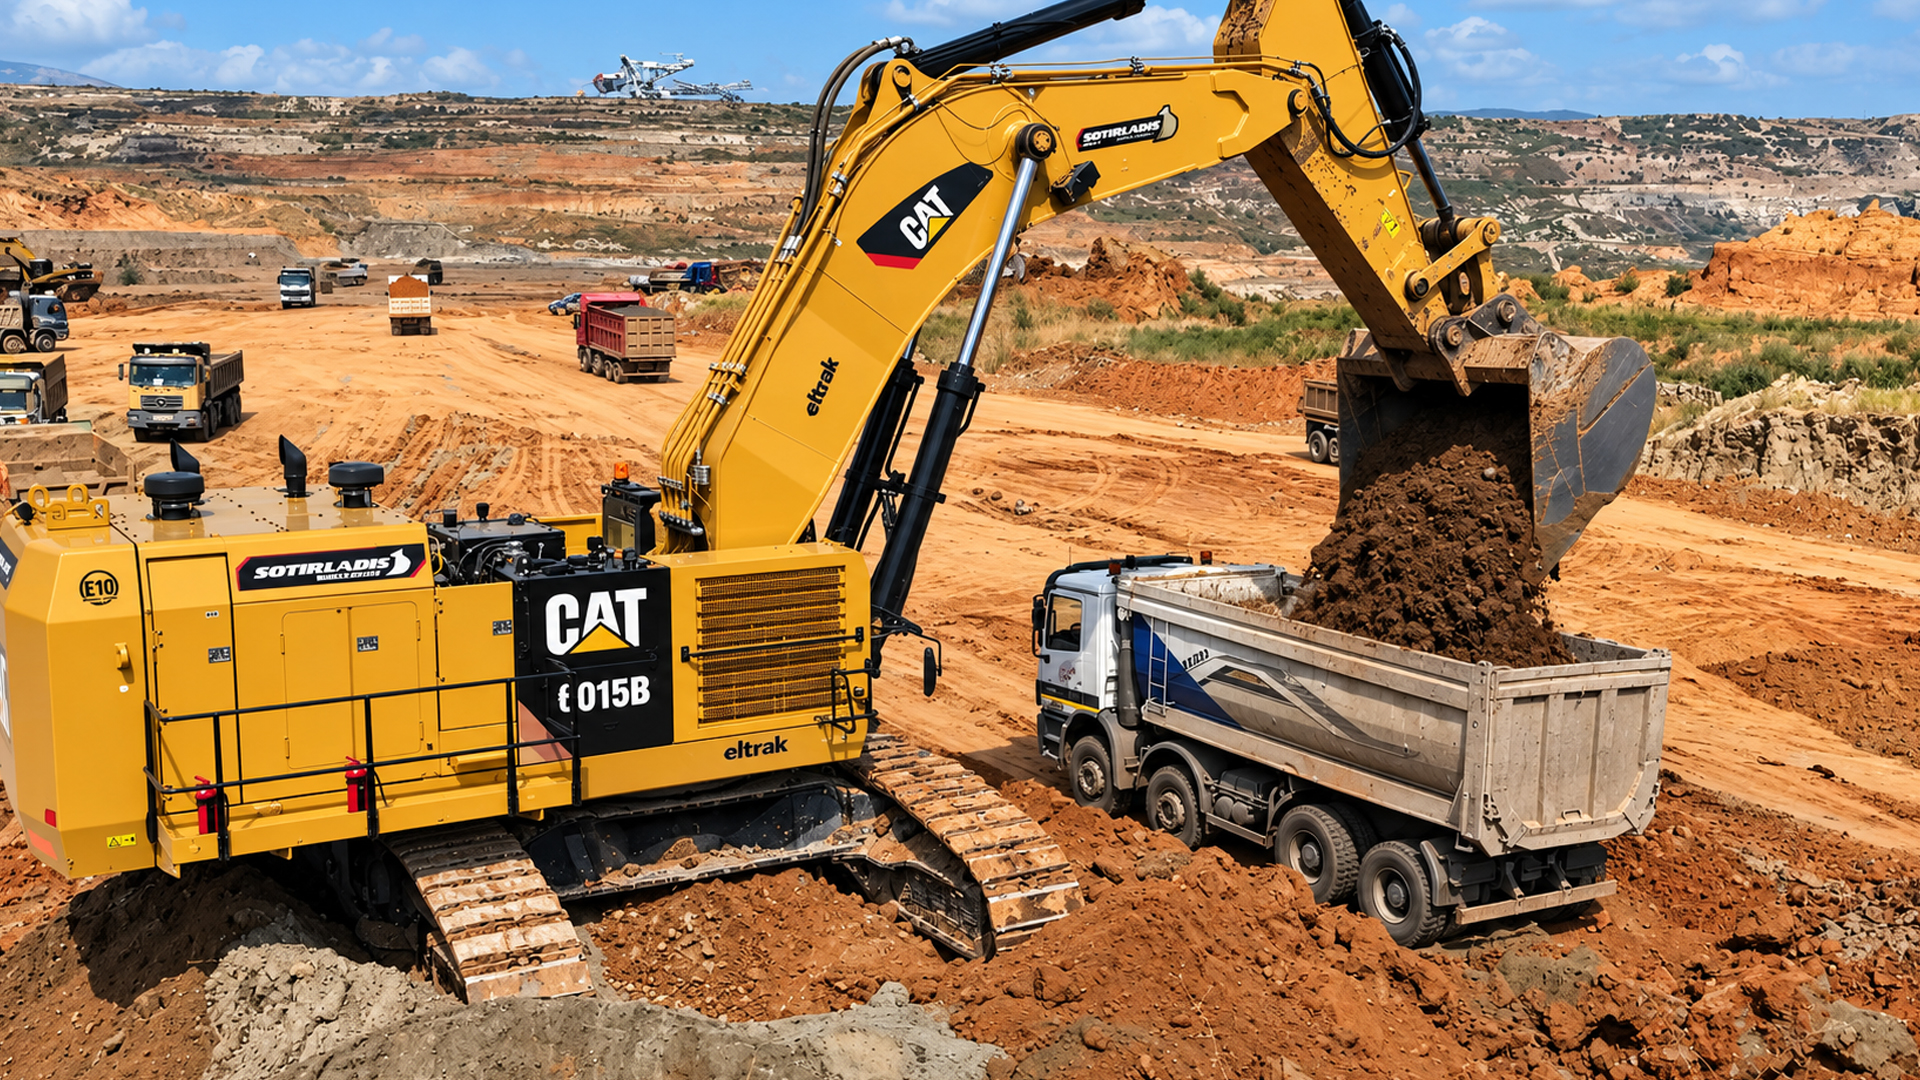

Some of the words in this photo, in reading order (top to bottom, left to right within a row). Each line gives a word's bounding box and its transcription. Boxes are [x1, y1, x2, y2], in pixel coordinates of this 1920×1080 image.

[1083, 120, 1161, 142] SOTIRLADIS
[899, 184, 954, 250] CAT
[806, 356, 840, 417] eltrak
[253, 557, 390, 580] SOTIRLADIS
[84, 578, 115, 598] E10
[545, 587, 648, 656] CAT
[723, 735, 789, 761] eltrak
